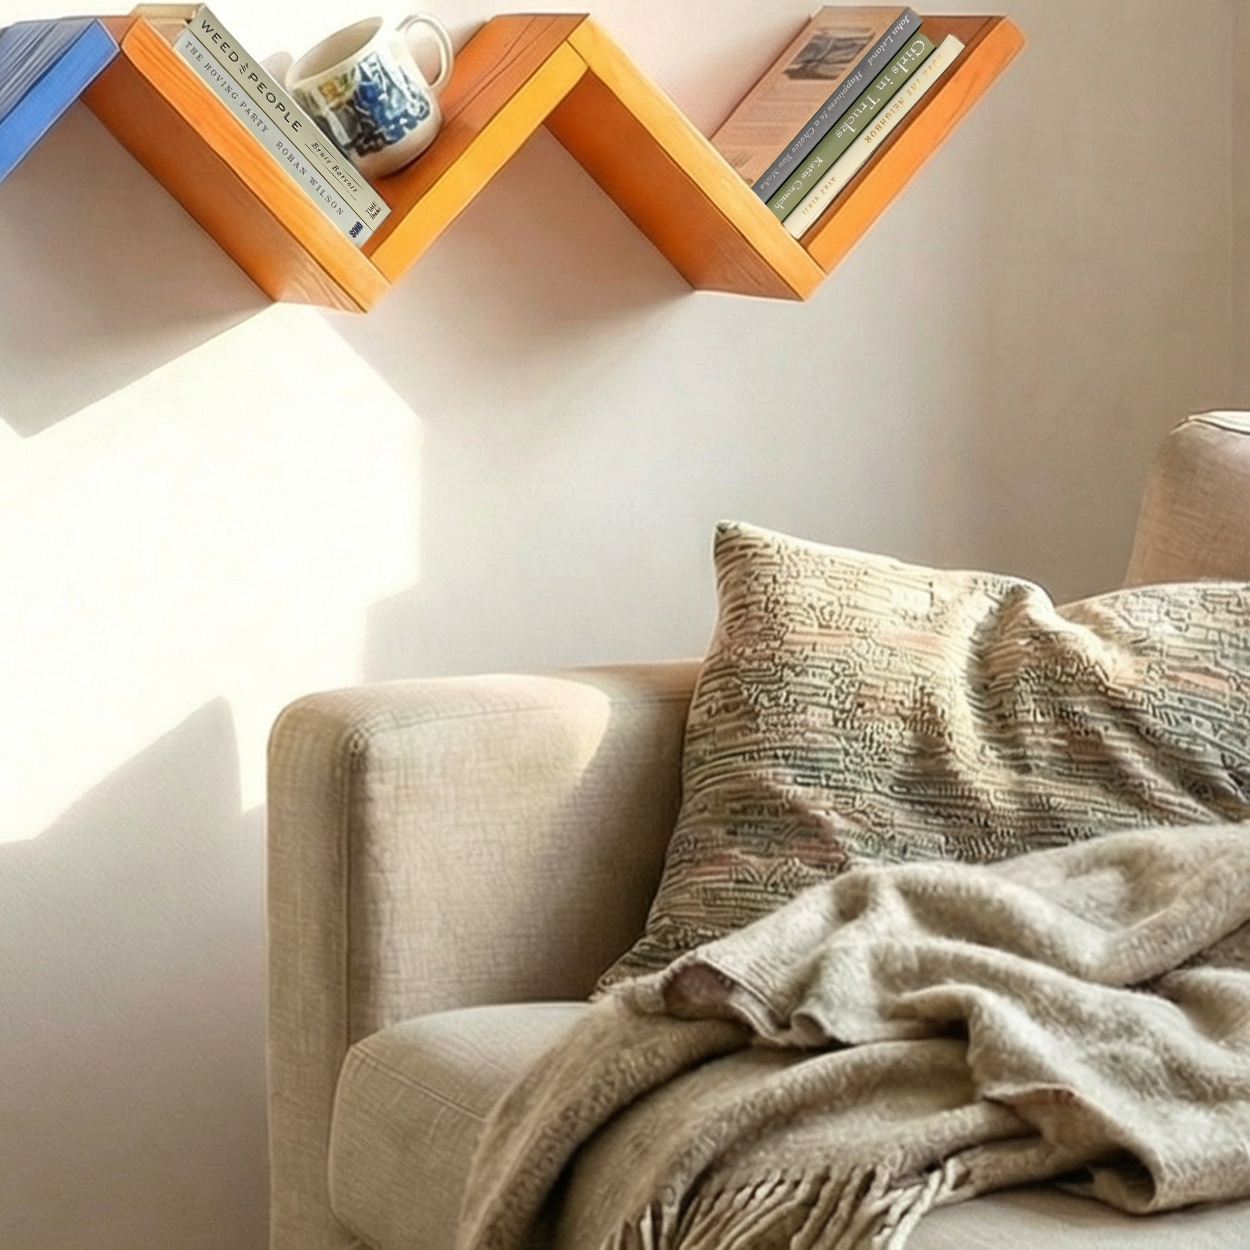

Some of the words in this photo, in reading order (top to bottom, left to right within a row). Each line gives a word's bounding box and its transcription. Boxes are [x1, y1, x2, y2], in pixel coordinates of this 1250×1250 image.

[891, 14, 911, 36] John
[867, 34, 894, 66] Leland
[891, 40, 925, 75] Girls
[201, 19, 240, 63] WEED
[247, 72, 303, 132] PEOPLE
[922, 53, 946, 79] LOVE
[827, 70, 864, 112] Happiness
[875, 75, 894, 91] in
[906, 78, 924, 98] THY
[184, 40, 204, 62] THE
[203, 62, 239, 100] ROVING
[239, 101, 270, 133] PARTY
[275, 140, 308, 176] ROHAN
[308, 175, 344, 216] WILSON
[819, 110, 828, 120] Is
[835, 93, 881, 138] Trucks
[863, 97, 907, 144] NEIGHBOR
[311, 141, 332, 164] Bruce
[791, 126, 815, 153] Choice
[778, 154, 793, 169] You
[801, 156, 824, 179] Katie
[759, 170, 780, 190] Make
[820, 176, 837, 195] AYAZ
[773, 179, 803, 210] Crouch
